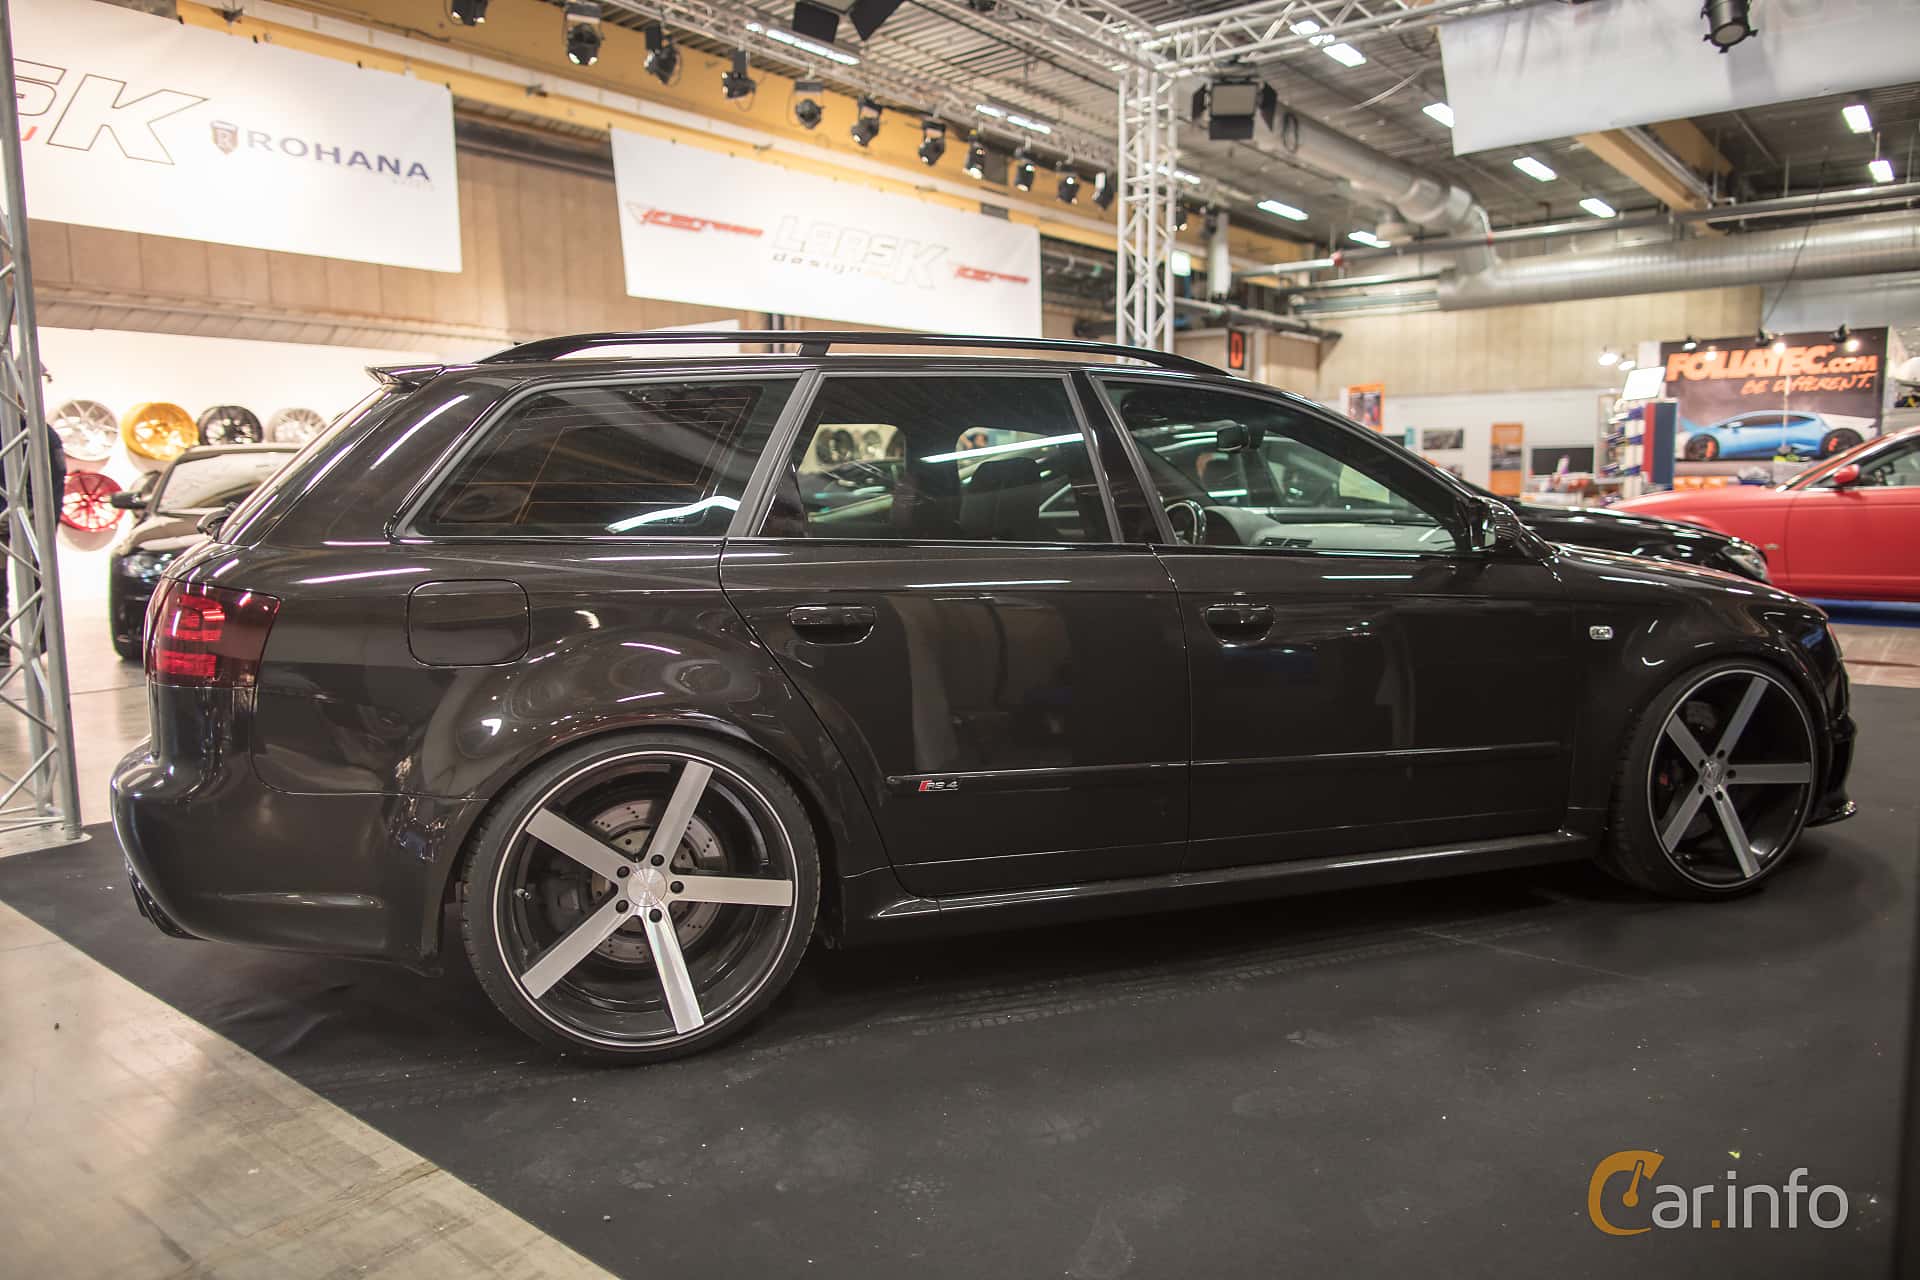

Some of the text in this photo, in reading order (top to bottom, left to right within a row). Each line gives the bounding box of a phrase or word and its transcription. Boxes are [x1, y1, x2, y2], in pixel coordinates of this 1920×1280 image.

[247, 130, 430, 181] ROHANA
[771, 251, 862, 275] design
[1740, 372, 1876, 395] BE DFFERENT.
